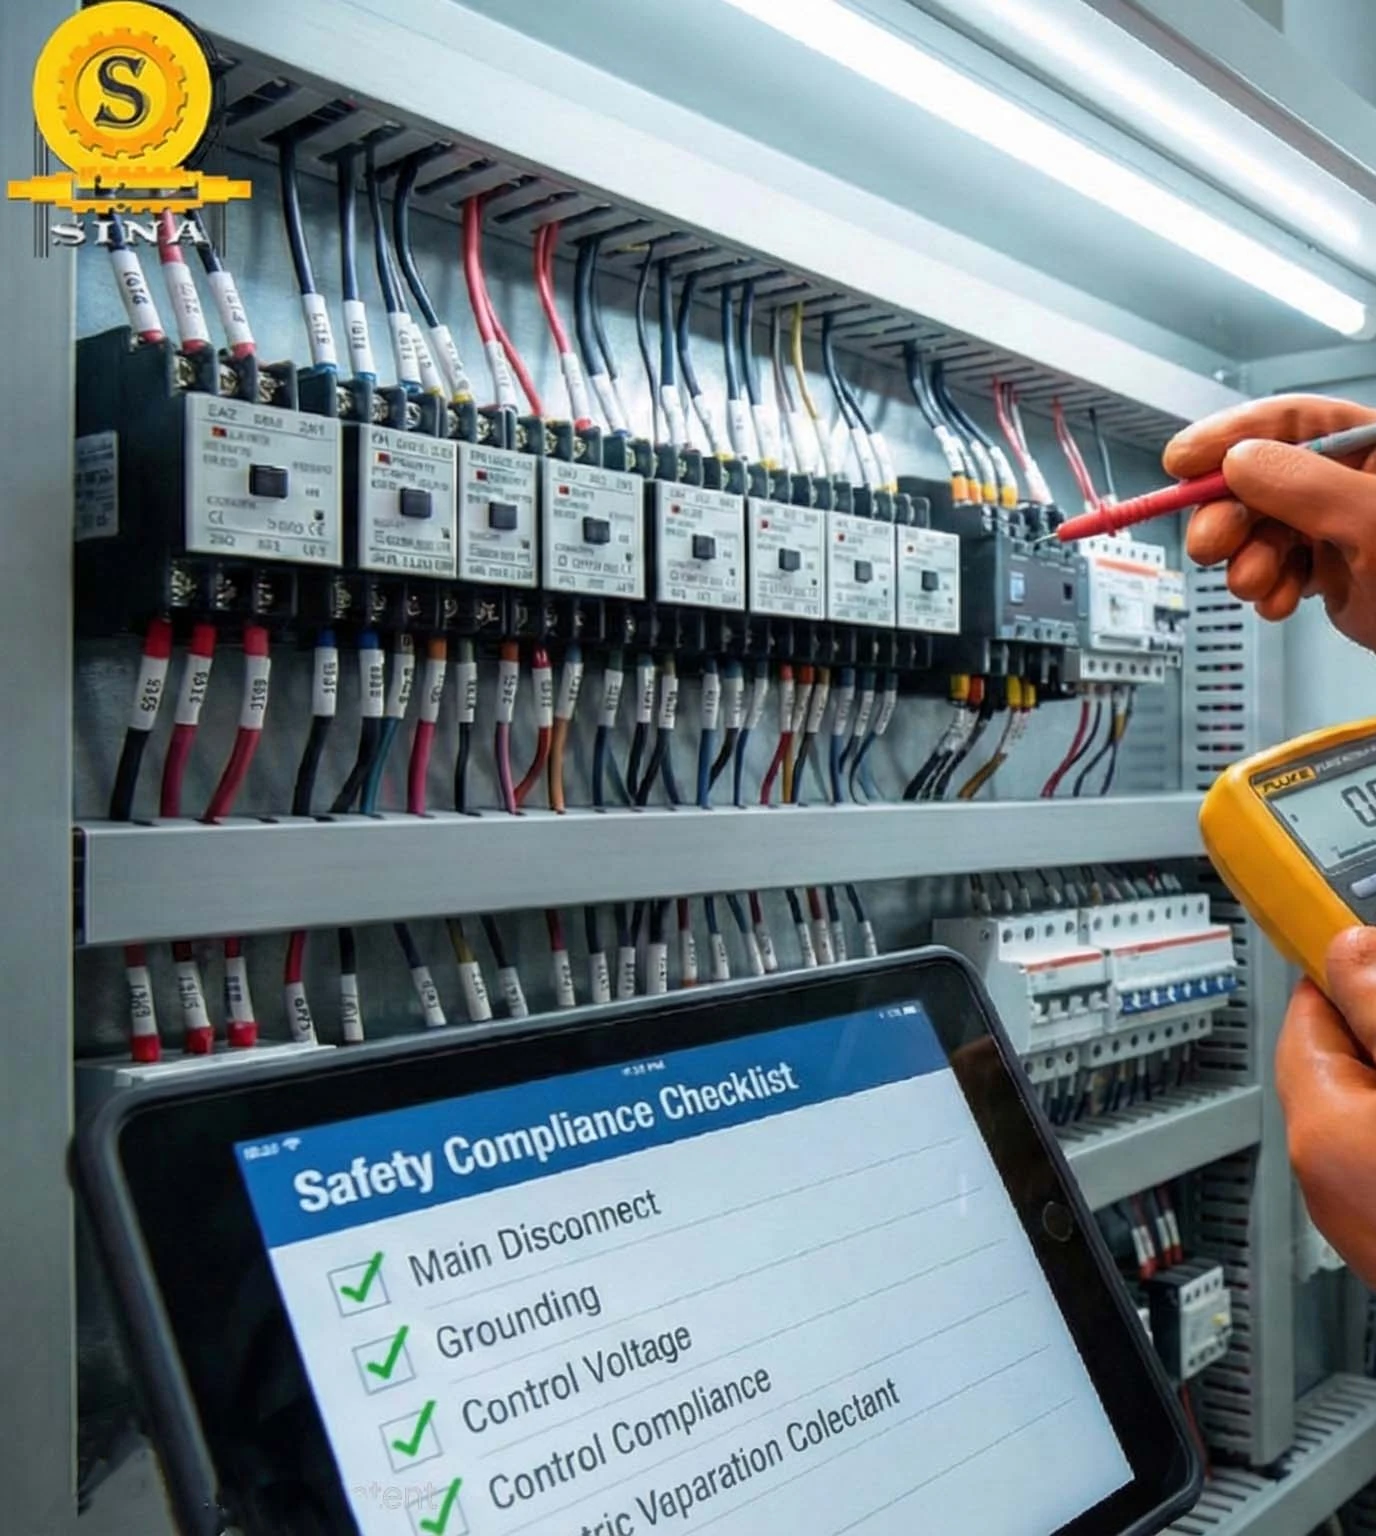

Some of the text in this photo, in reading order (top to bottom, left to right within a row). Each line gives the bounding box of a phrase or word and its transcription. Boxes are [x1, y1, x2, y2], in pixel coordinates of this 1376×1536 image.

[293, 1061, 800, 1212] Safety Compliance Checklist
[409, 1189, 662, 1287] Main Disconnect
[436, 1285, 602, 1359] Grounding
[462, 1326, 692, 1434] Control Voltage
[786, 1378, 901, 1452] Colectant
[489, 1368, 772, 1509] Control Compliance
